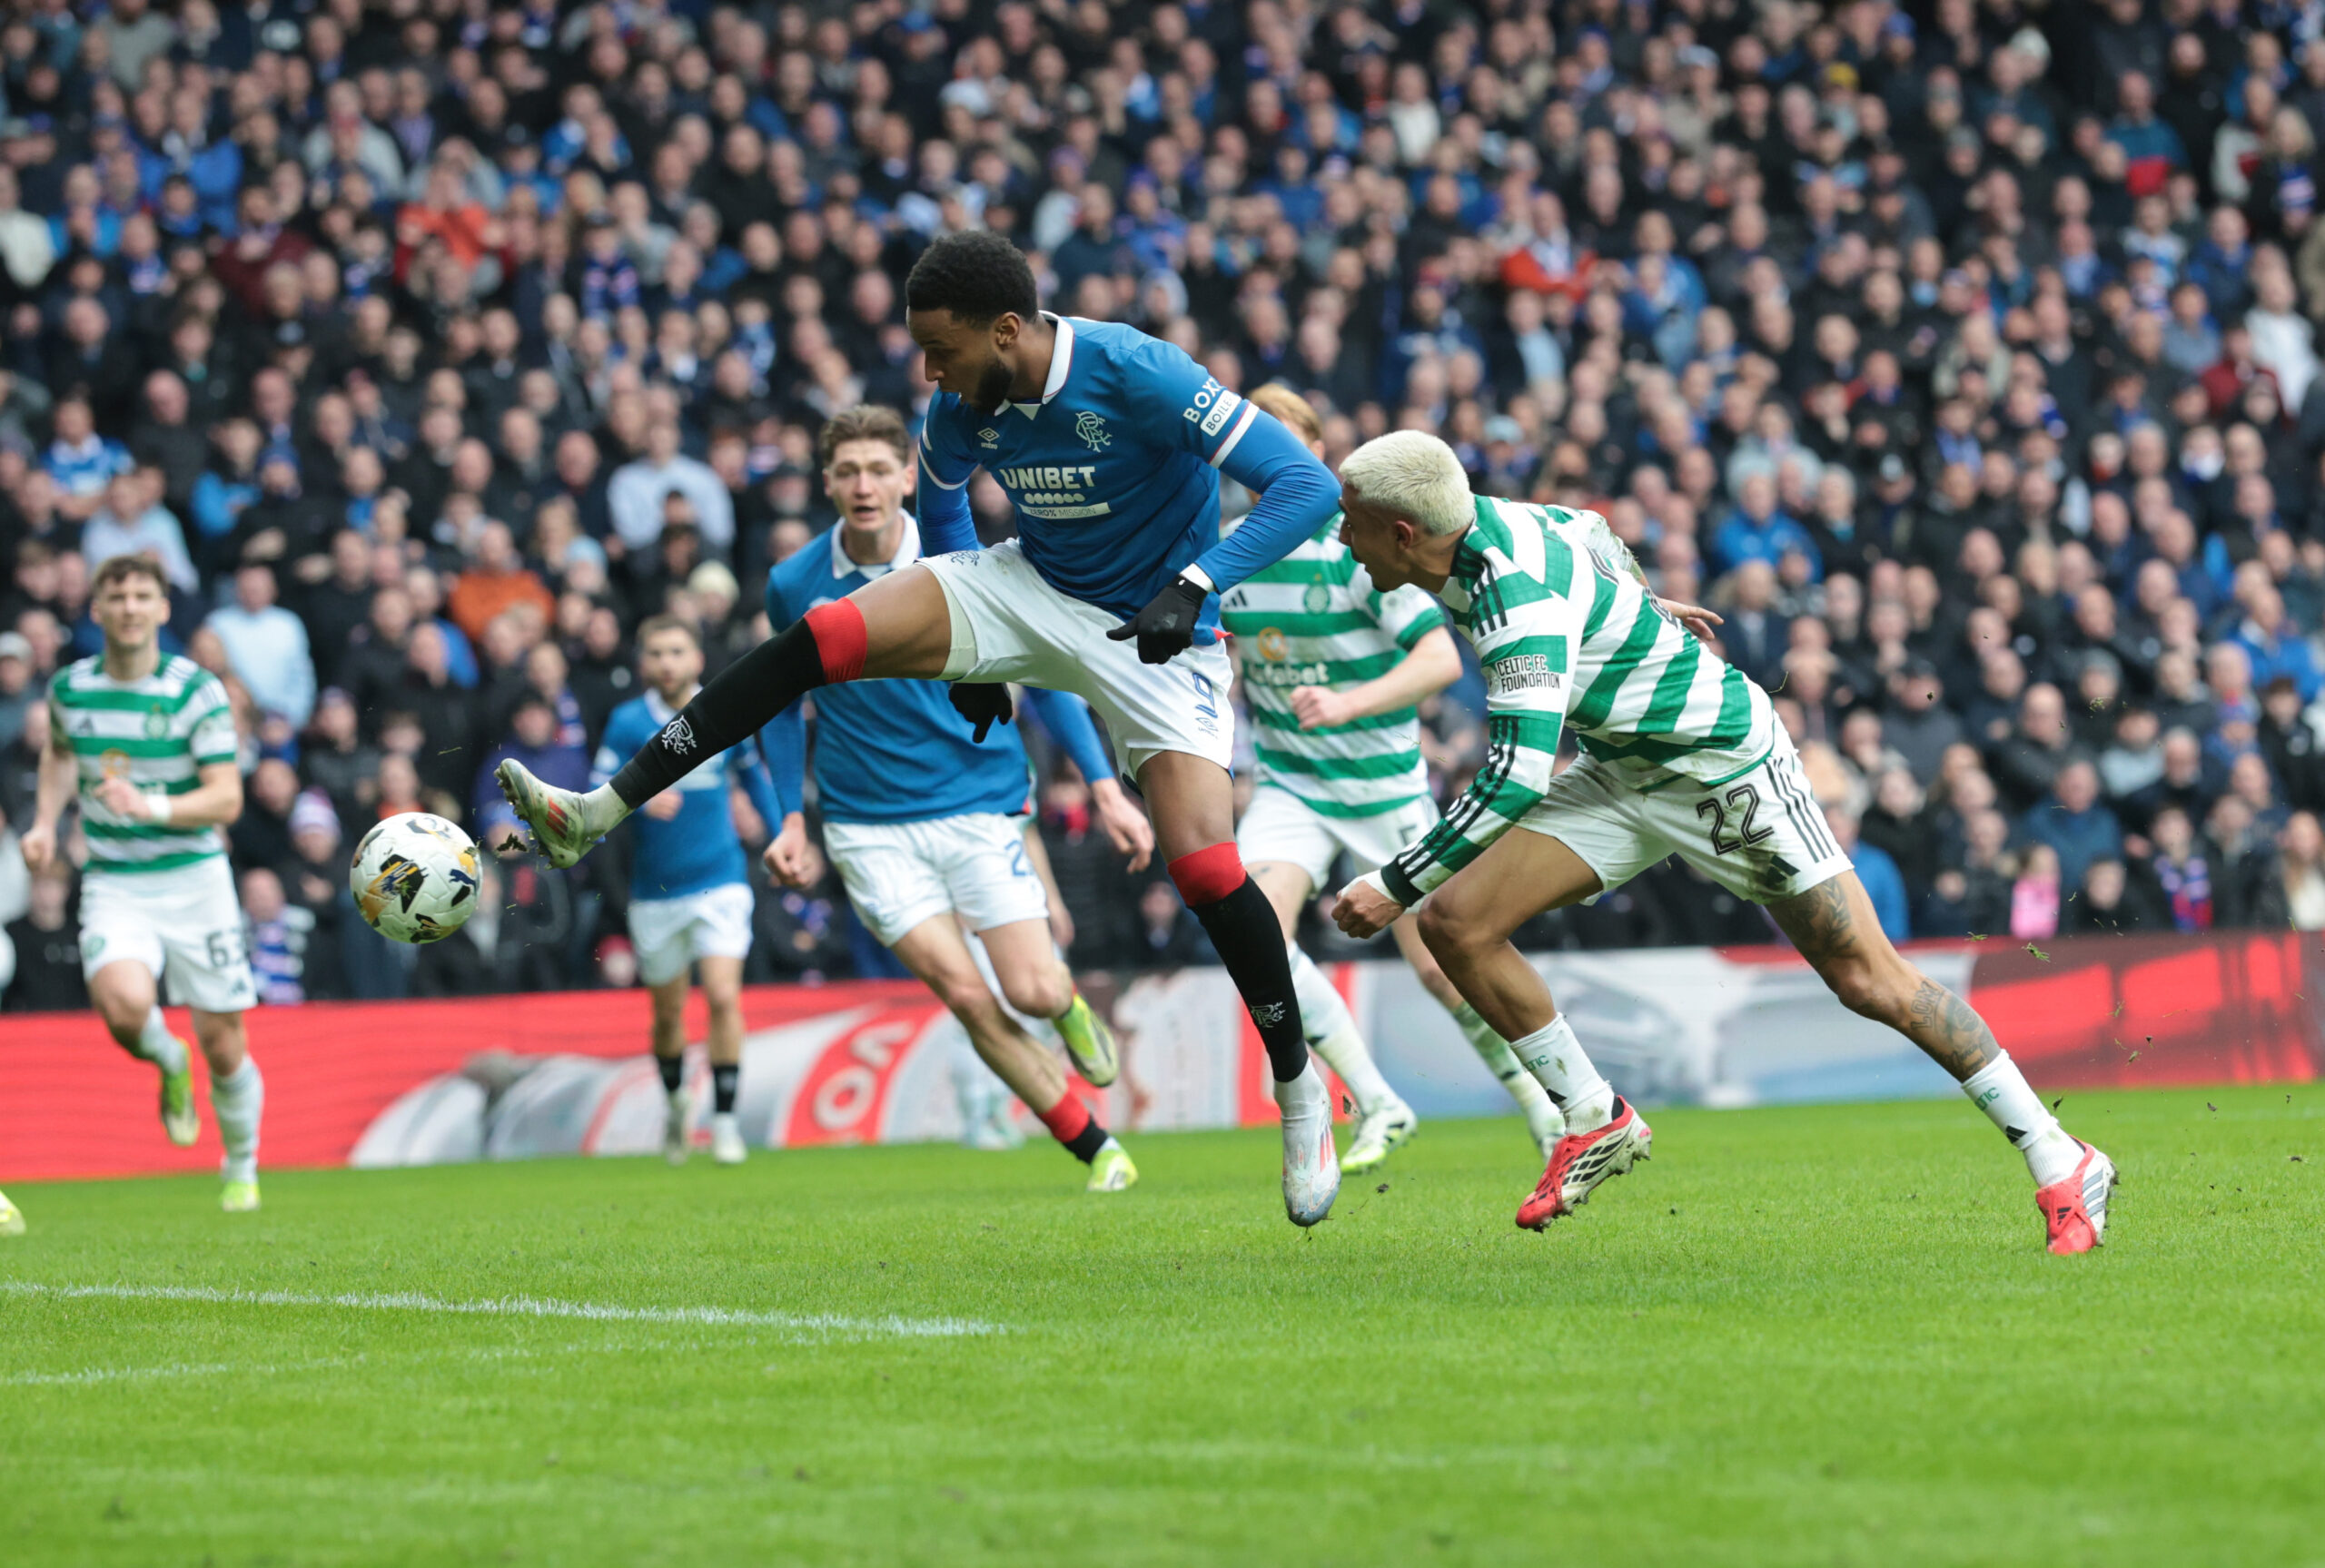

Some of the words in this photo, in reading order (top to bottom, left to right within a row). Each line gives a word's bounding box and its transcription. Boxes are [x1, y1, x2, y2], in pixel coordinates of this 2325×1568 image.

[1206, 396, 1234, 430] BOILE
[999, 466, 1095, 489] UNIBET
[1059, 507, 1096, 518] MISSION
[1496, 656, 1531, 676] CELTIC
[1534, 655, 1548, 671] FC
[1500, 672, 1560, 693] FOUNDATION
[1696, 784, 1775, 856] 22
